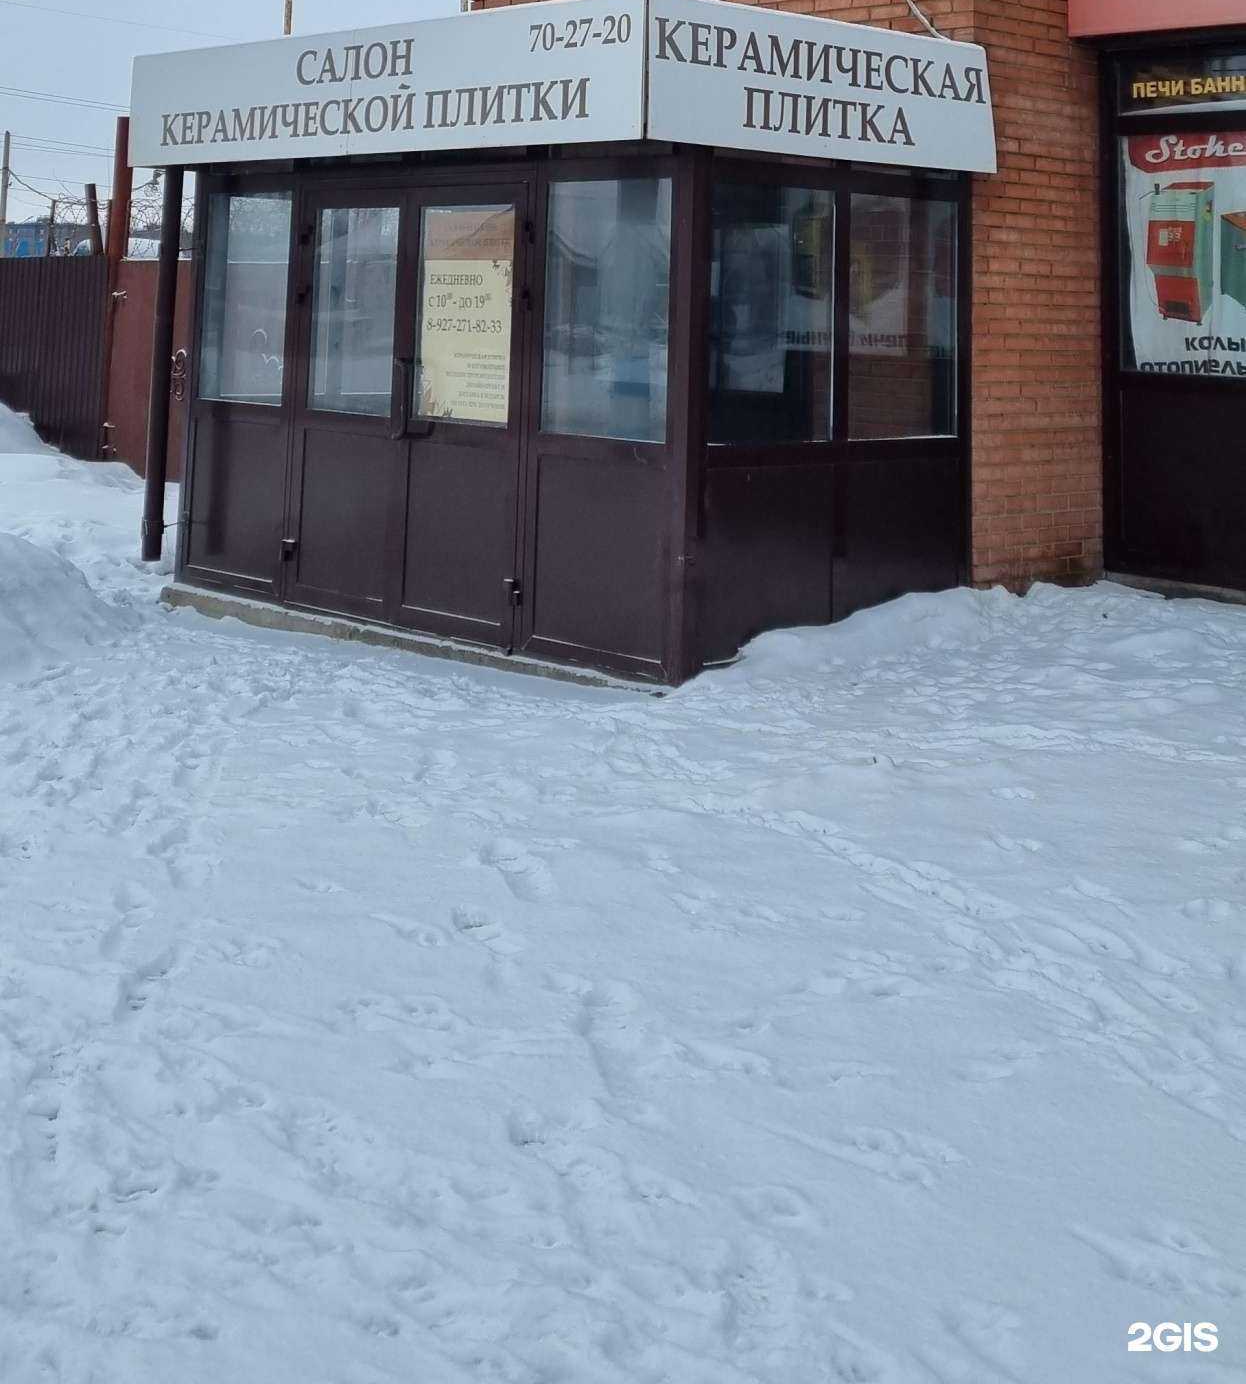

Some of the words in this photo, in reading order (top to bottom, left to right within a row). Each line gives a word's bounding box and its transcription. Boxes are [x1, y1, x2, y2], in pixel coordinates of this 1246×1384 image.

[529, 13, 632, 53] 70-27-20
[296, 38, 415, 86] САЛОН
[655, 17, 986, 104] КЕРАМИЧЕСКАЯ
[1132, 80, 1184, 98] ПЕЧИ
[1190, 75, 1246, 94] БАНН
[160, 82, 415, 147] КЕРАМИЧЕСКОЙ
[423, 77, 590, 130] ПЛИТКИ
[743, 86, 915, 146] ПЛИТКА
[430, 273, 483, 285] ЕЖЕДНЕВНО
[459, 297, 472, 308] ДО
